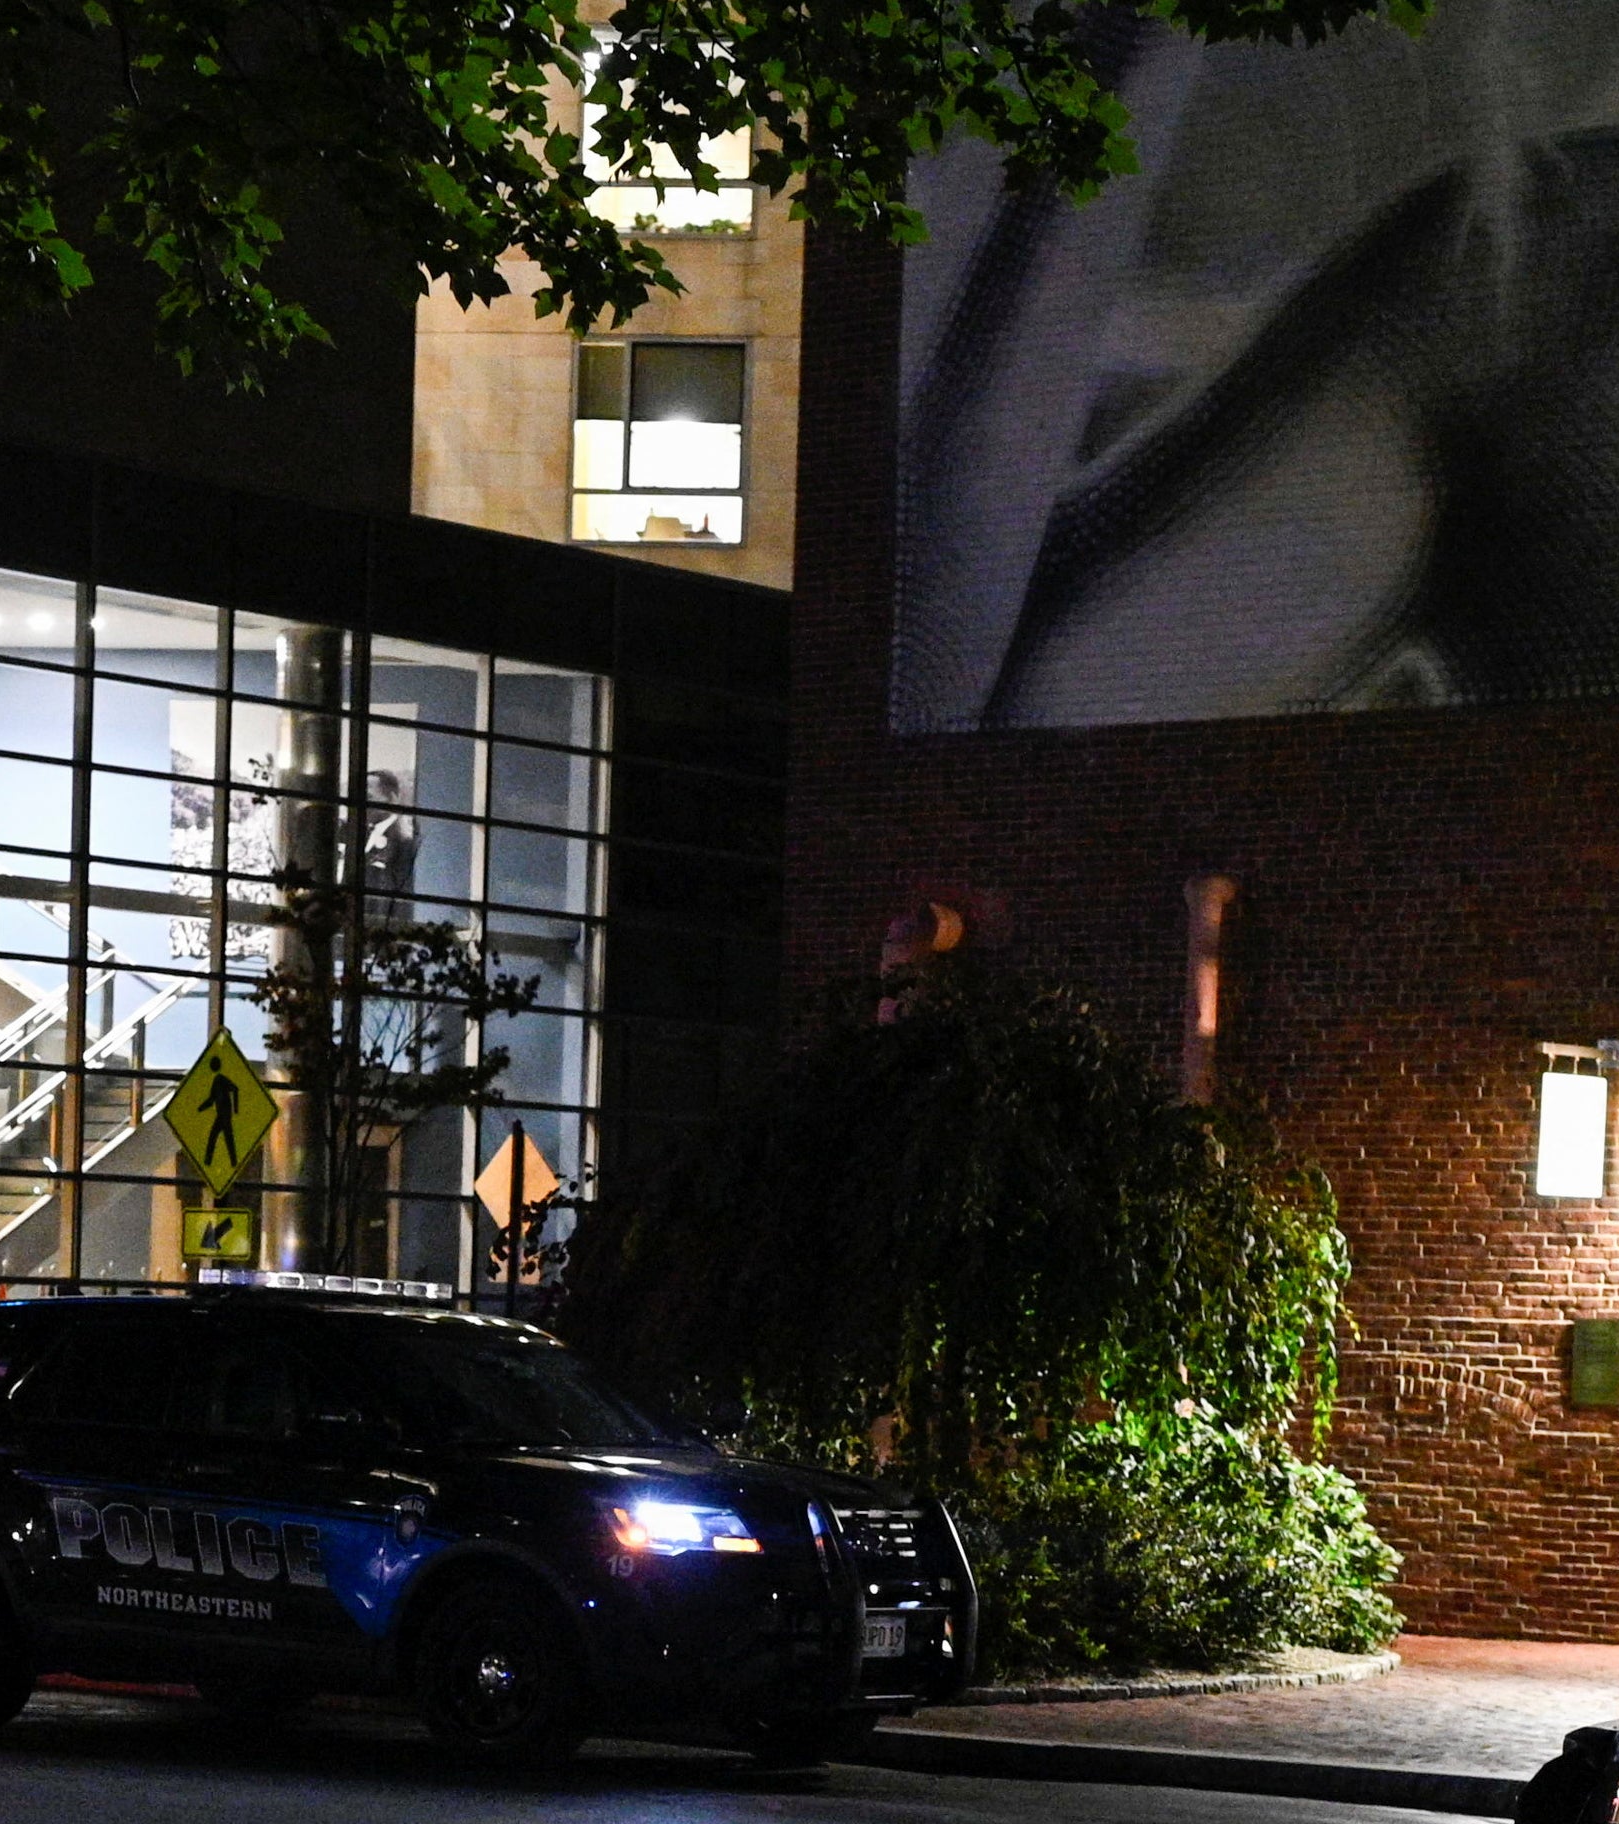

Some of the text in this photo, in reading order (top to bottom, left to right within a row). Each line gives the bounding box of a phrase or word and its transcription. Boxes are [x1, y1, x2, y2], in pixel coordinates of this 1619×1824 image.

[51, 1497, 329, 1588] POLICE
[606, 1555, 635, 1578] 19
[97, 1585, 274, 1621] NORTHEASTERN
